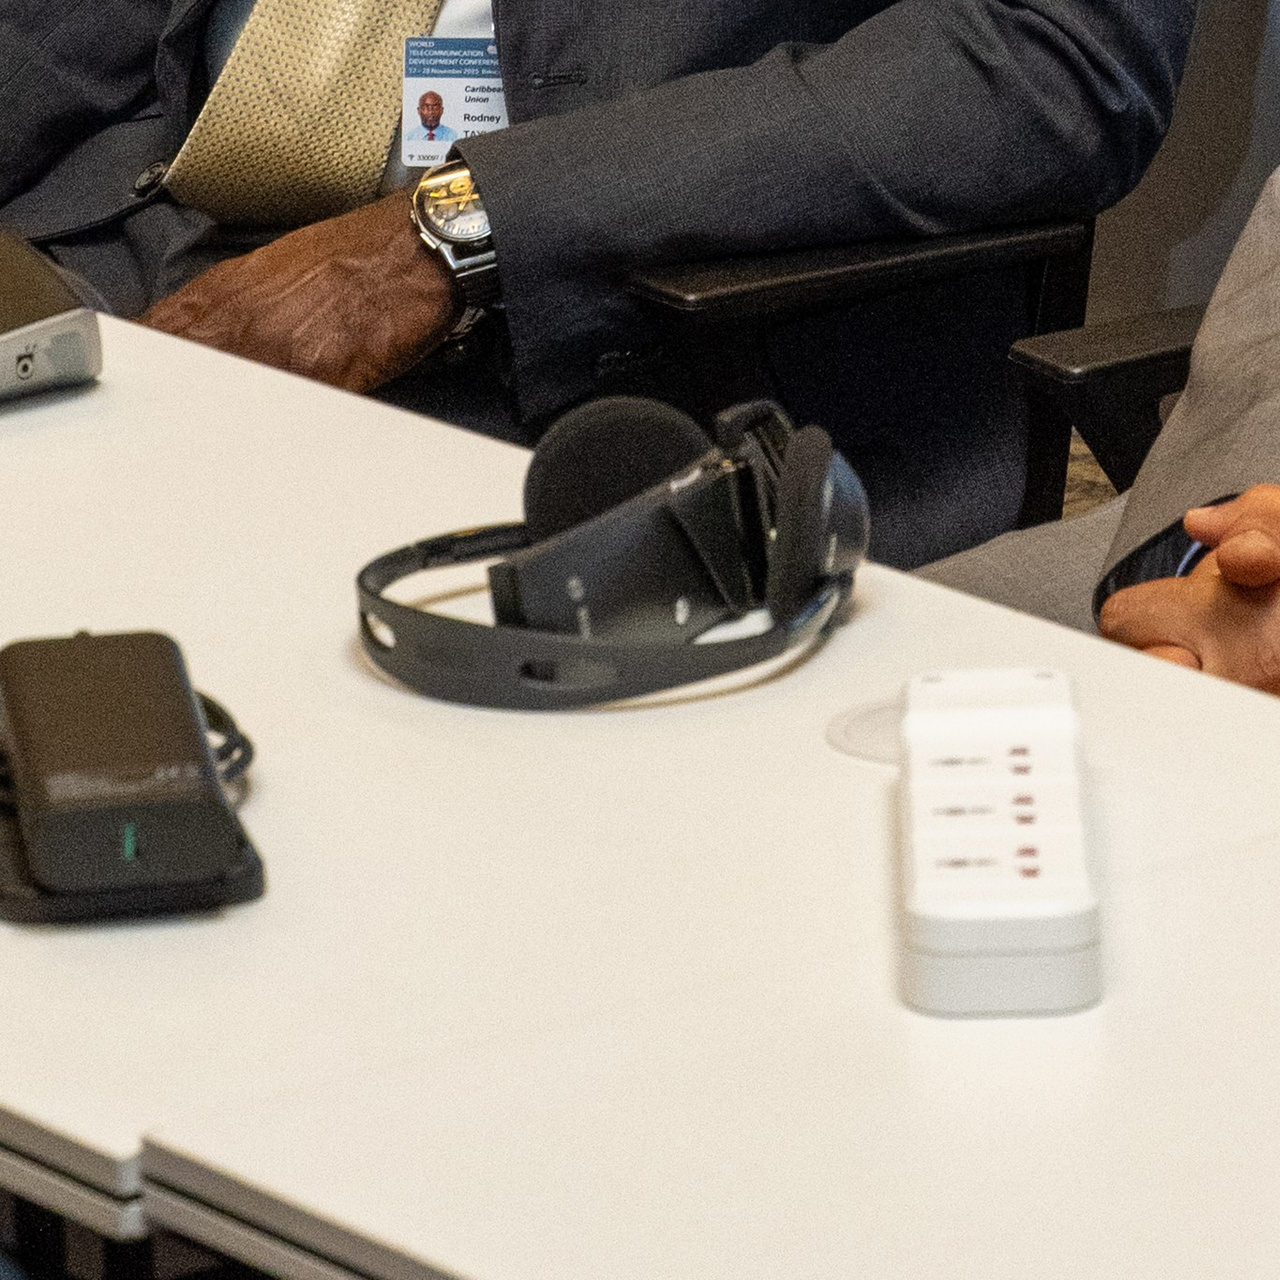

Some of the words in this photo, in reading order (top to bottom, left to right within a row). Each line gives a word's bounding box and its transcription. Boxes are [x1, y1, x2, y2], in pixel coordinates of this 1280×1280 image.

[409, 49, 484, 57] TELECOMMUNICATION
[408, 58, 458, 66] DEVELOPMENT
[464, 95, 489, 103] Union
[463, 113, 501, 124] Rodney
